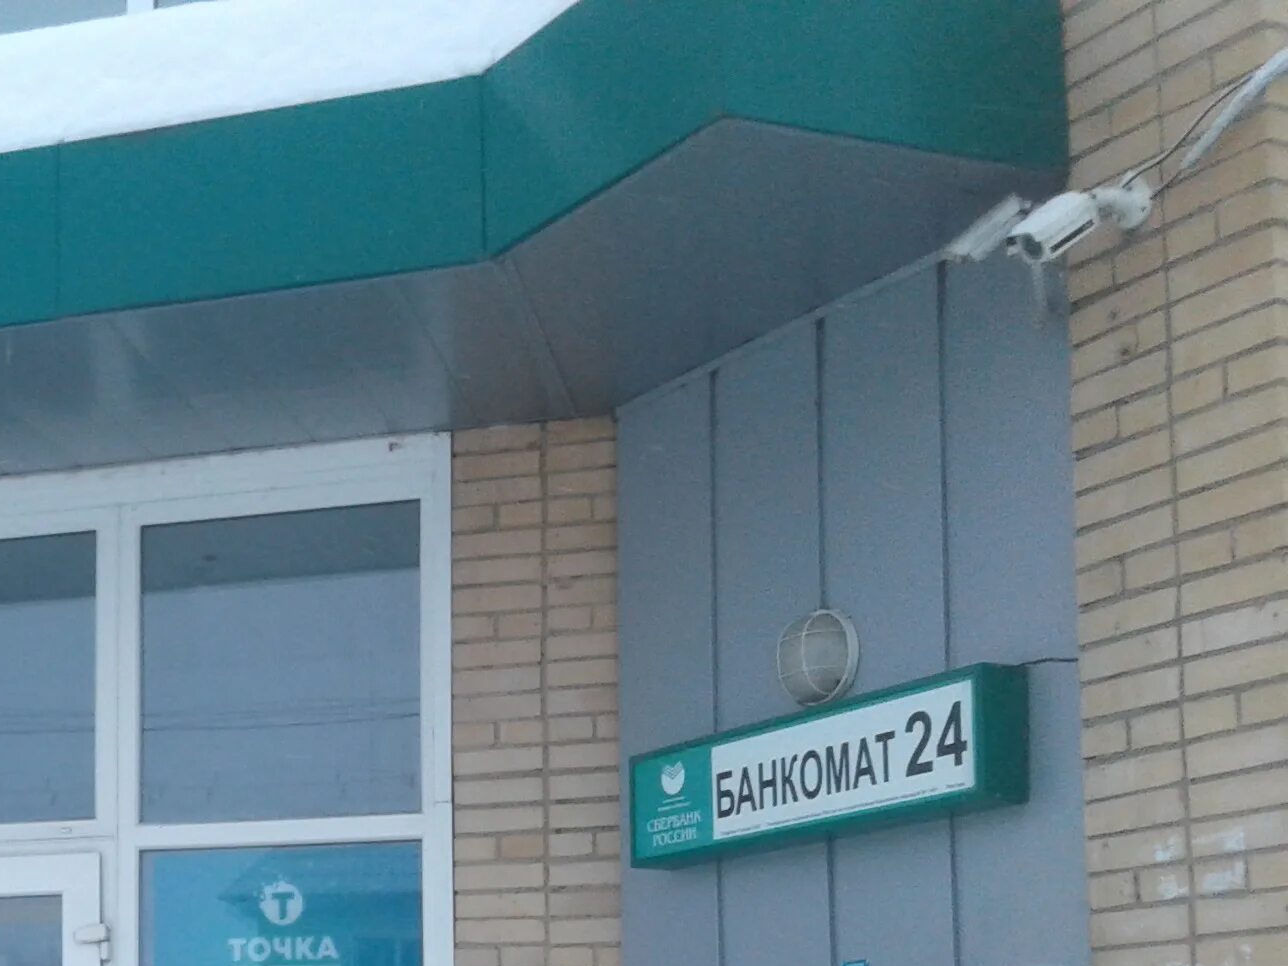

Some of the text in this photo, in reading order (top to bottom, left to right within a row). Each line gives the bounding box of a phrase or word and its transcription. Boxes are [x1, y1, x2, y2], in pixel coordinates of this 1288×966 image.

[716, 701, 969, 819] БАНКОМАТ 24
[646, 810, 702, 832] СБЕРБАНК
[653, 826, 697, 847] РОССИИ
[227, 935, 340, 961] ТОЧКА
